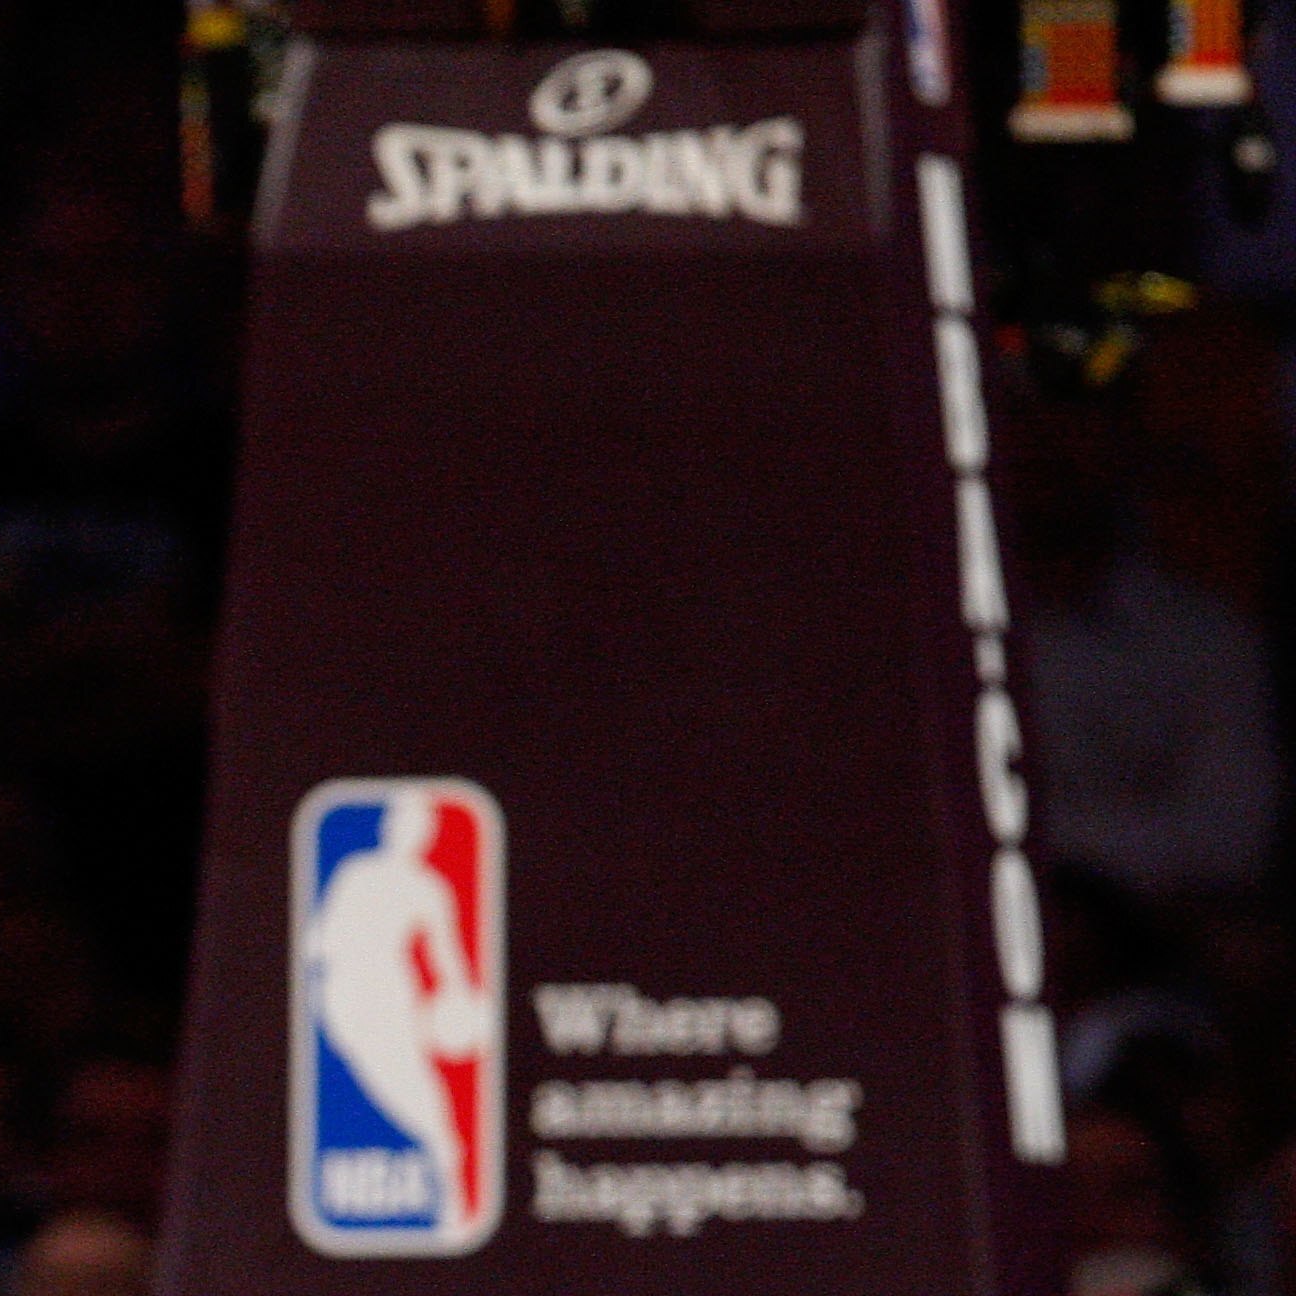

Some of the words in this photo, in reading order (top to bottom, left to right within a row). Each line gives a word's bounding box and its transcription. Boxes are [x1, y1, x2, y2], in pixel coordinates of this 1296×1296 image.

[366, 116, 806, 231] SPALDING
[534, 983, 779, 1053] Where
[533, 1068, 861, 1149] amazing
[534, 1151, 864, 1237] happens.
